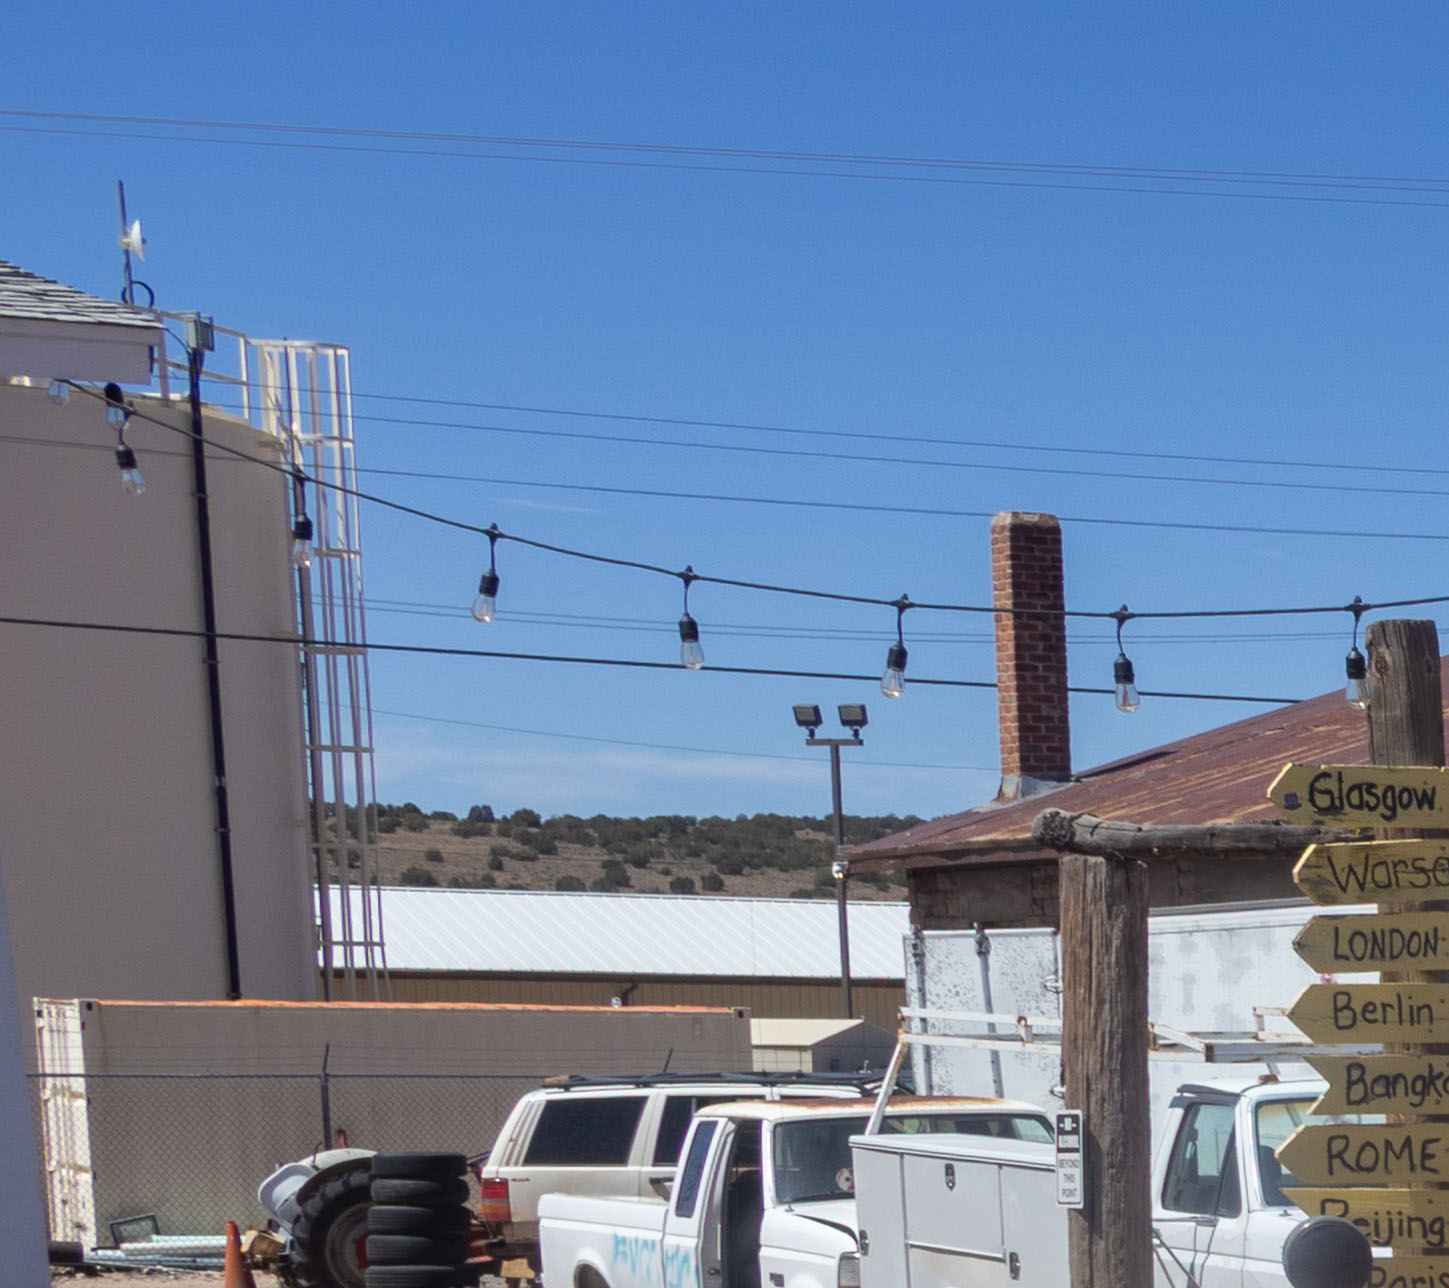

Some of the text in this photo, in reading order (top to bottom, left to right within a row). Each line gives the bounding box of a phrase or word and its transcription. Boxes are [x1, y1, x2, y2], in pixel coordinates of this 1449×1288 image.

[1308, 771, 1437, 822] Glasgow
[1333, 926, 1440, 962] LONDON
[1332, 991, 1434, 1031] Berlin
[1326, 1134, 1442, 1177] ROME
